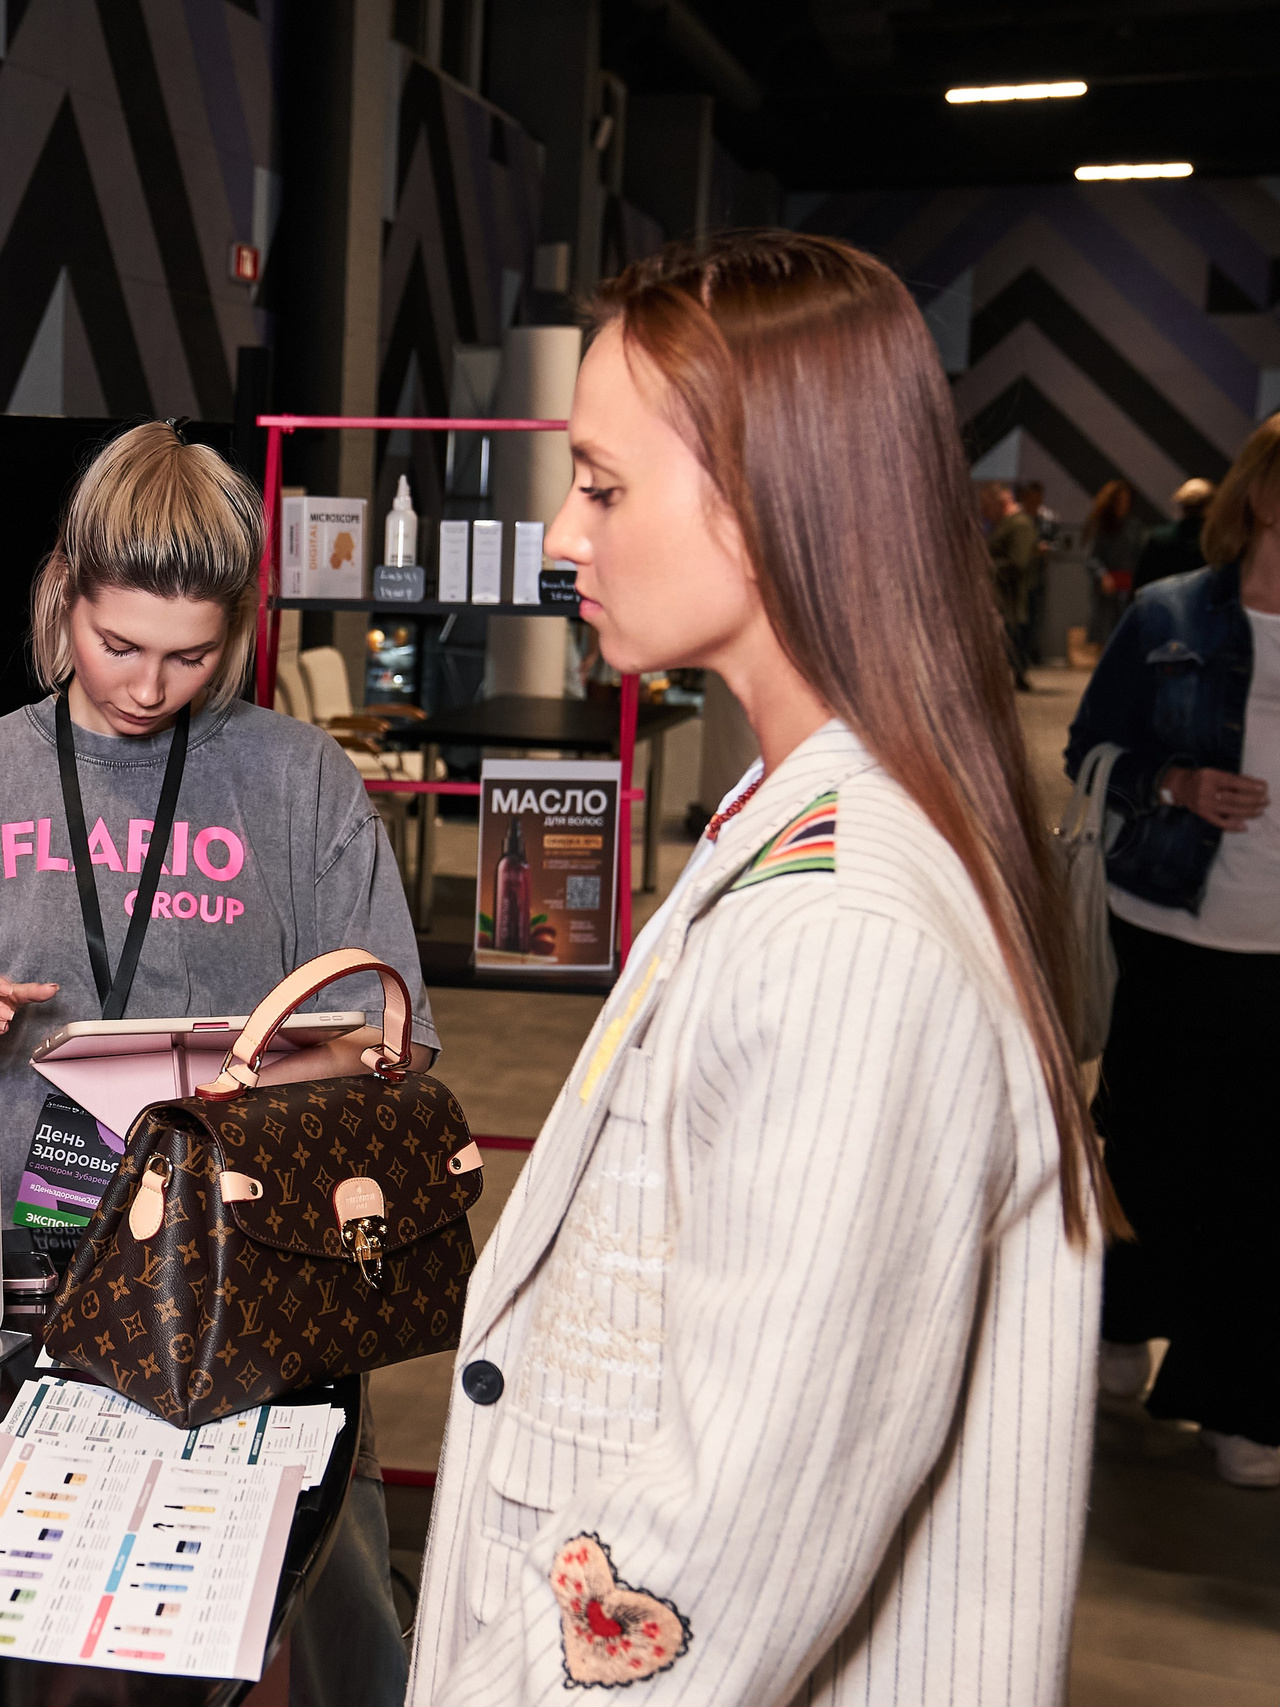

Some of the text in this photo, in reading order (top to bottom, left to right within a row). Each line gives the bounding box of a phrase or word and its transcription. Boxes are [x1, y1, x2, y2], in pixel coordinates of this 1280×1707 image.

[310, 513, 360, 524] MICROSCOPE
[309, 524, 318, 570] DIGITAL
[492, 788, 607, 814] МАСЛО
[544, 816, 604, 827] для волос
[35, 1123, 85, 1148] День
[32, 1144, 119, 1174] здоровья
[34, 1162, 73, 1177] доктором
[30, 1183, 99, 1206] #Деньздоровья202
